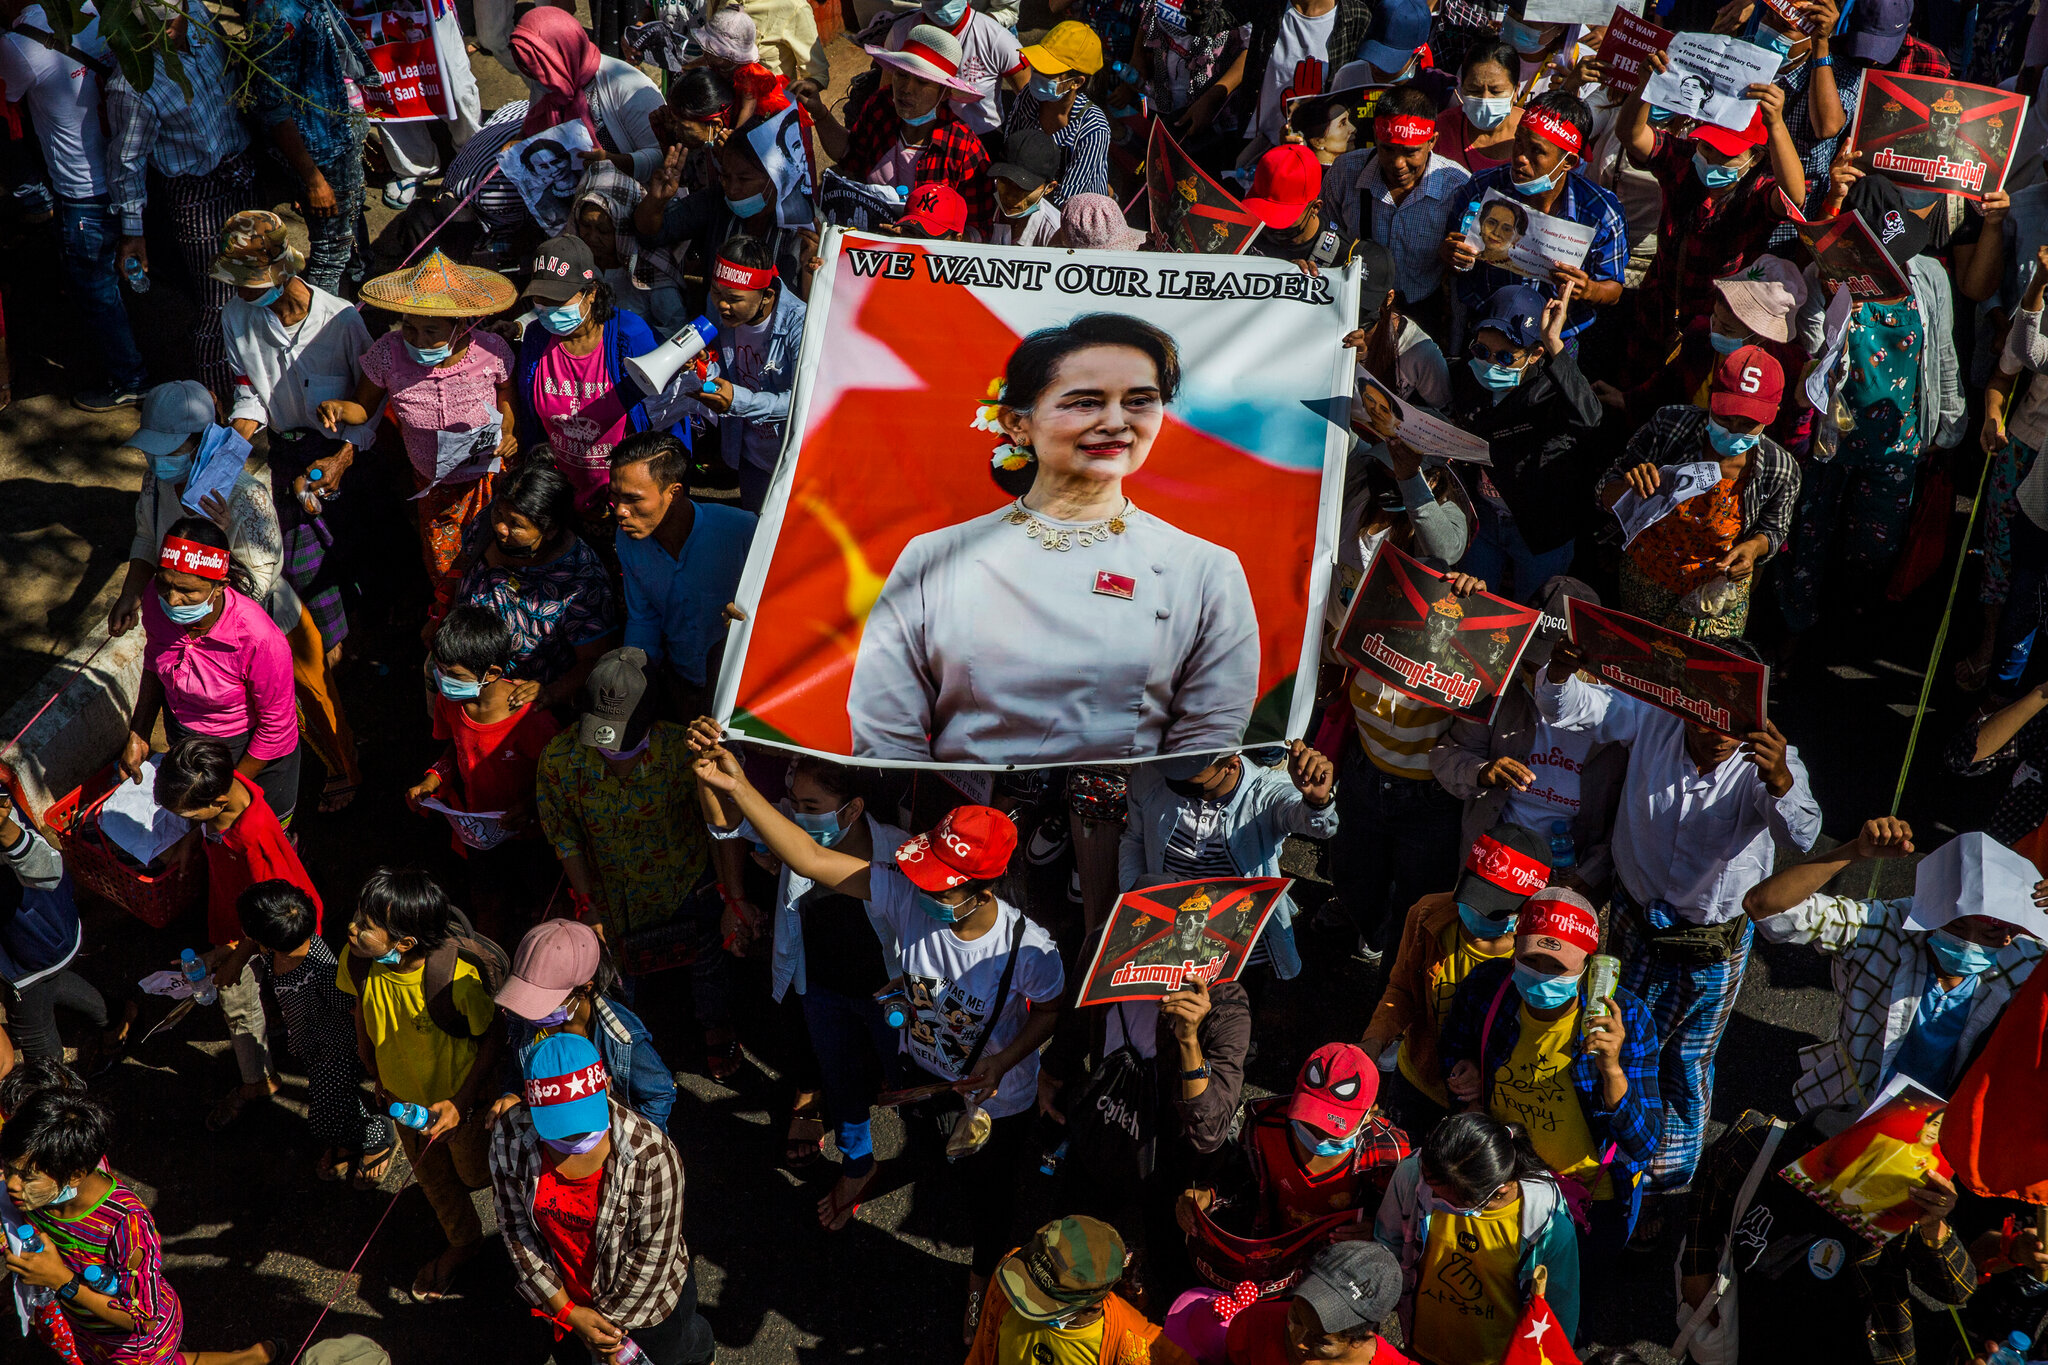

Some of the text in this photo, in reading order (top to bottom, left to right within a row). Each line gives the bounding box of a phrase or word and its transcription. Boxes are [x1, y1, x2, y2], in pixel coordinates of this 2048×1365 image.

[1623, 17, 1658, 39] WE WANT
[1611, 29, 1658, 54] OUR LEADER
[1612, 53, 1640, 75] FRE
[1683, 49, 1730, 70] Free Our Leaders
[1697, 43, 1723, 57] Condemn
[1724, 53, 1746, 66] Military
[1746, 61, 1762, 71] Coup
[398, 61, 437, 80] Leader
[1679, 57, 1736, 84] We Need Democracy
[394, 85, 417, 101] San
[418, 82, 440, 97] Suu
[823, 189, 895, 224] FIGHT FOR DEMOCRA
[1567, 236, 1588, 246] Myanmar
[721, 265, 753, 285] DEMOCRACY
[846, 247, 915, 280] WE
[922, 253, 1051, 291] WANT
[1055, 263, 1151, 299] OUR
[1156, 269, 1335, 305] LEADER
[1739, 366, 1763, 393] S
[939, 826, 971, 858] SCG
[940, 976, 986, 1012] #TAG ME!
[1493, 1087, 1564, 1132] Happy
[1460, 1233, 1476, 1250] Love
